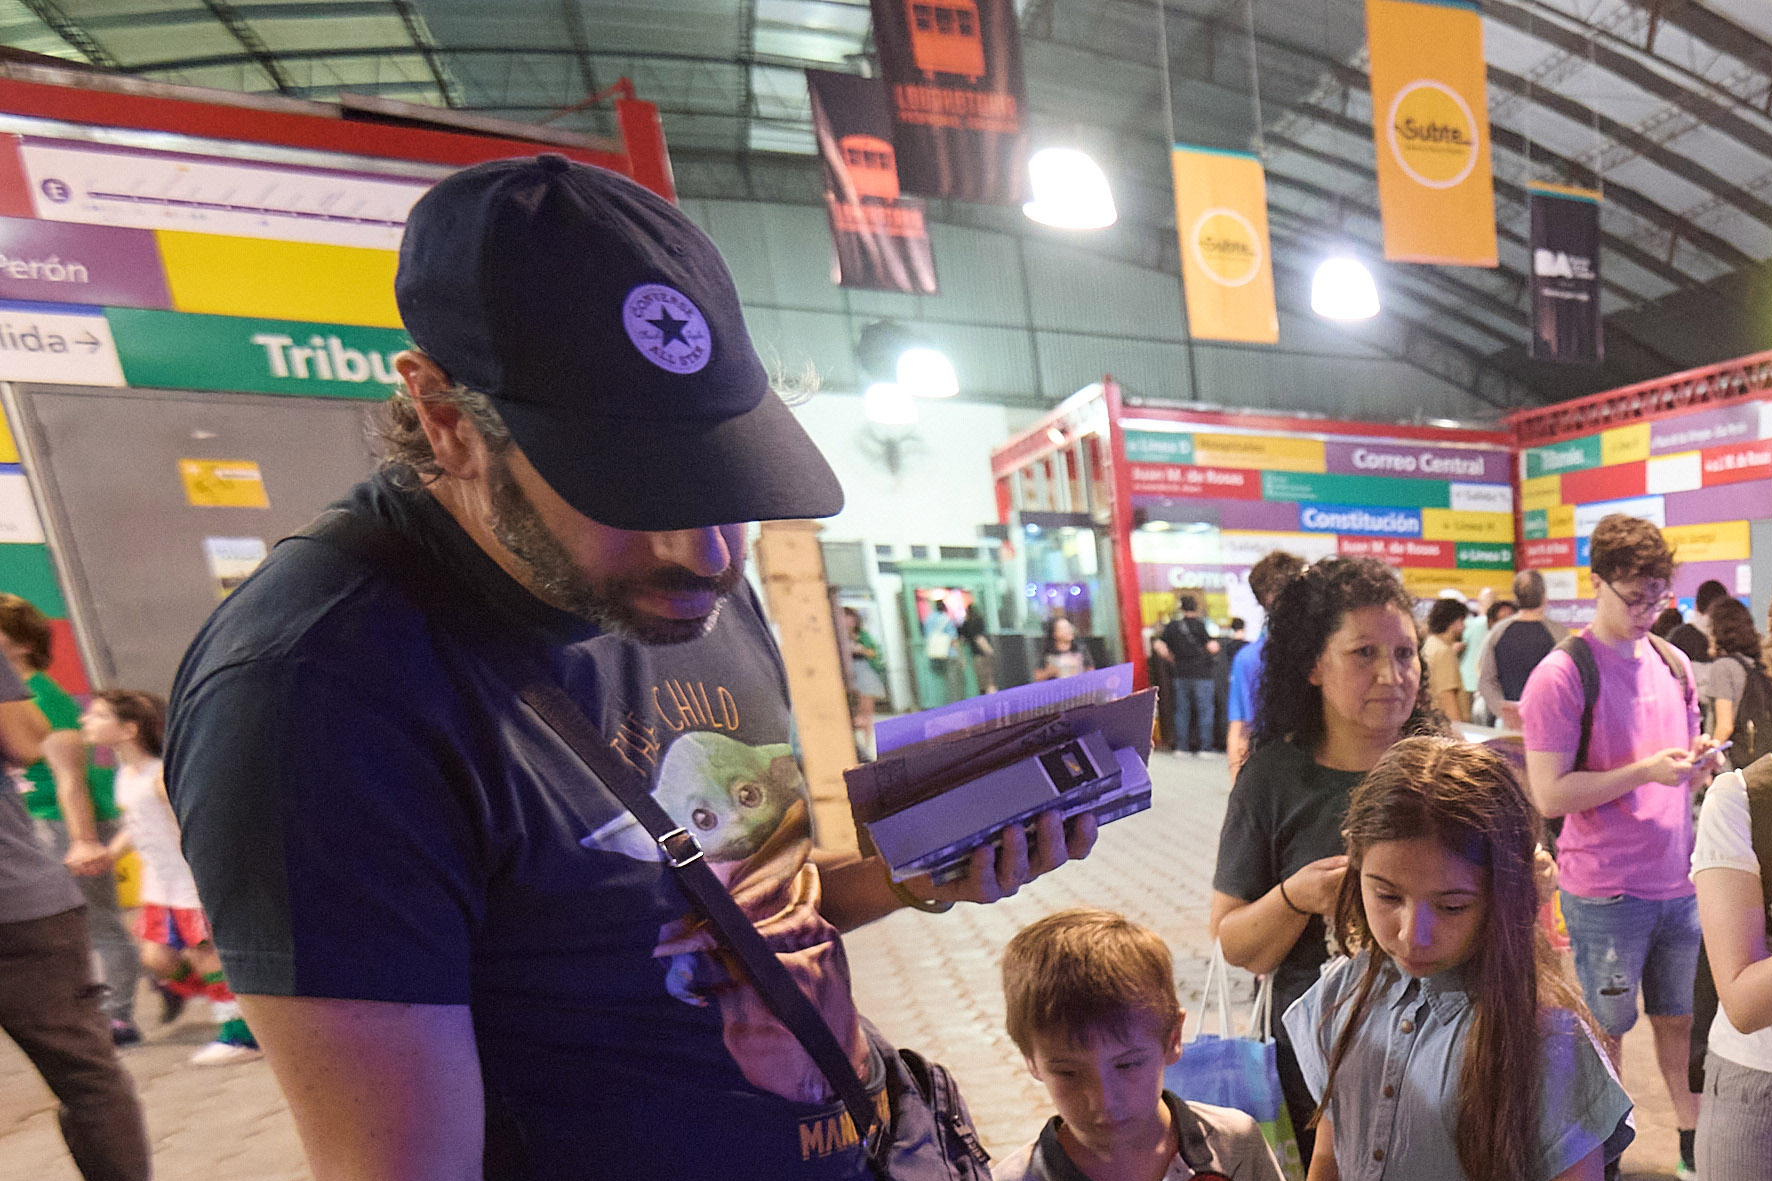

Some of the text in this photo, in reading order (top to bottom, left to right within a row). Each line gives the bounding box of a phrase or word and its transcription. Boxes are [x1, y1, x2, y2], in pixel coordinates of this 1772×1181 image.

[1351, 447, 1486, 477] Correo Central
[1302, 508, 1420, 534] Constitución
[609, 678, 740, 778] THE CHILD
